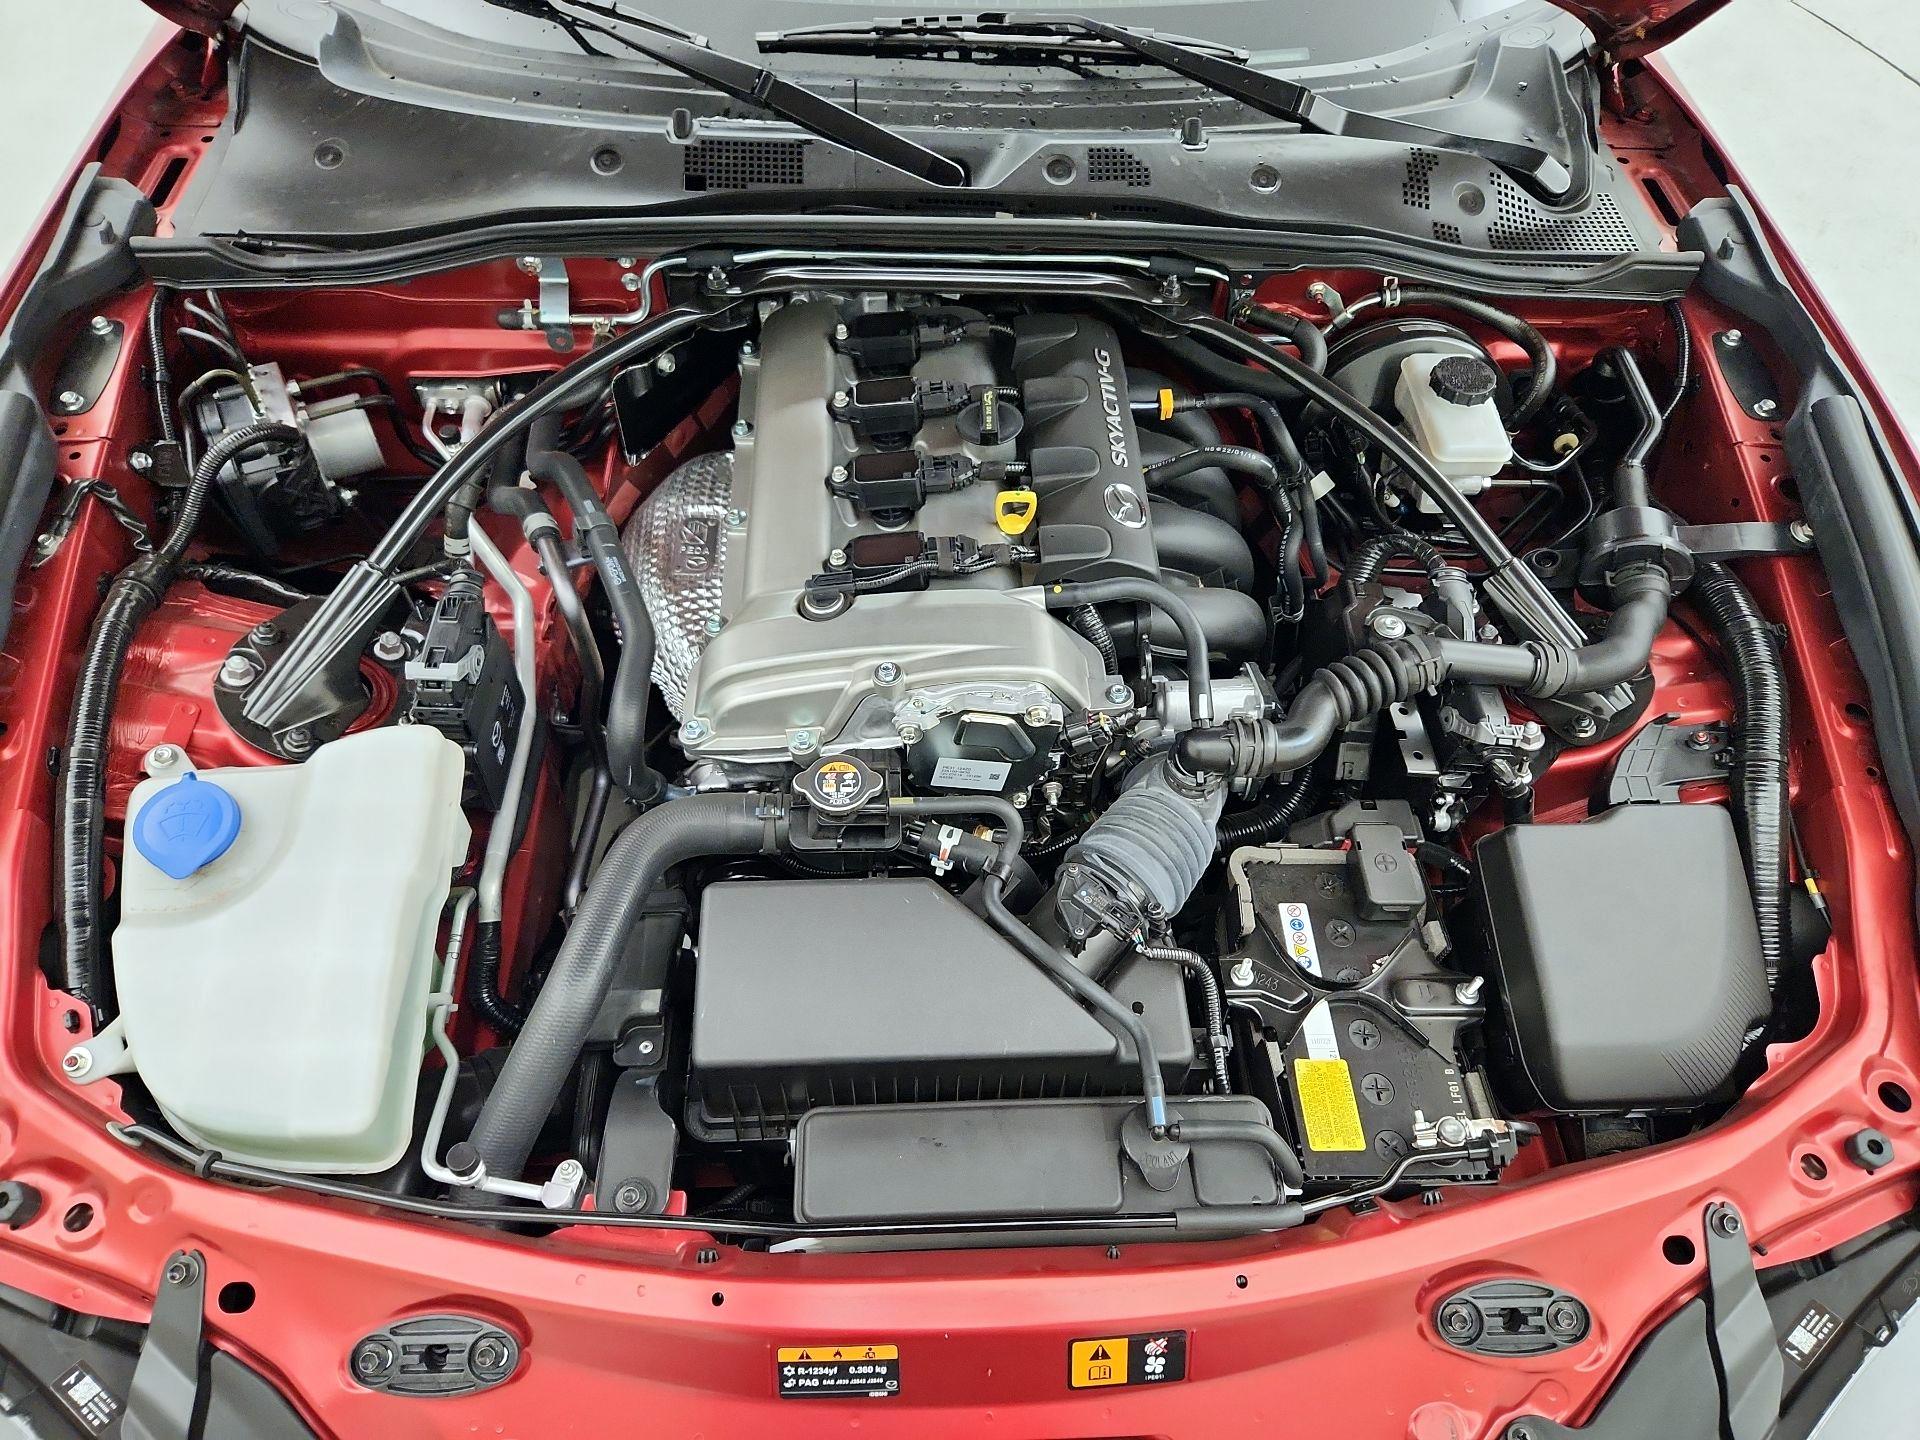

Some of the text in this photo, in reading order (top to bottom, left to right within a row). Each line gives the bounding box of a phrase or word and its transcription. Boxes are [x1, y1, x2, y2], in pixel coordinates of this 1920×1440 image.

[1095, 347, 1128, 468] SKYACTIV-G
[797, 1366, 838, 1376] R-1234yf
[875, 1365, 888, 1375] kg
[798, 1378, 819, 1387] PAG
